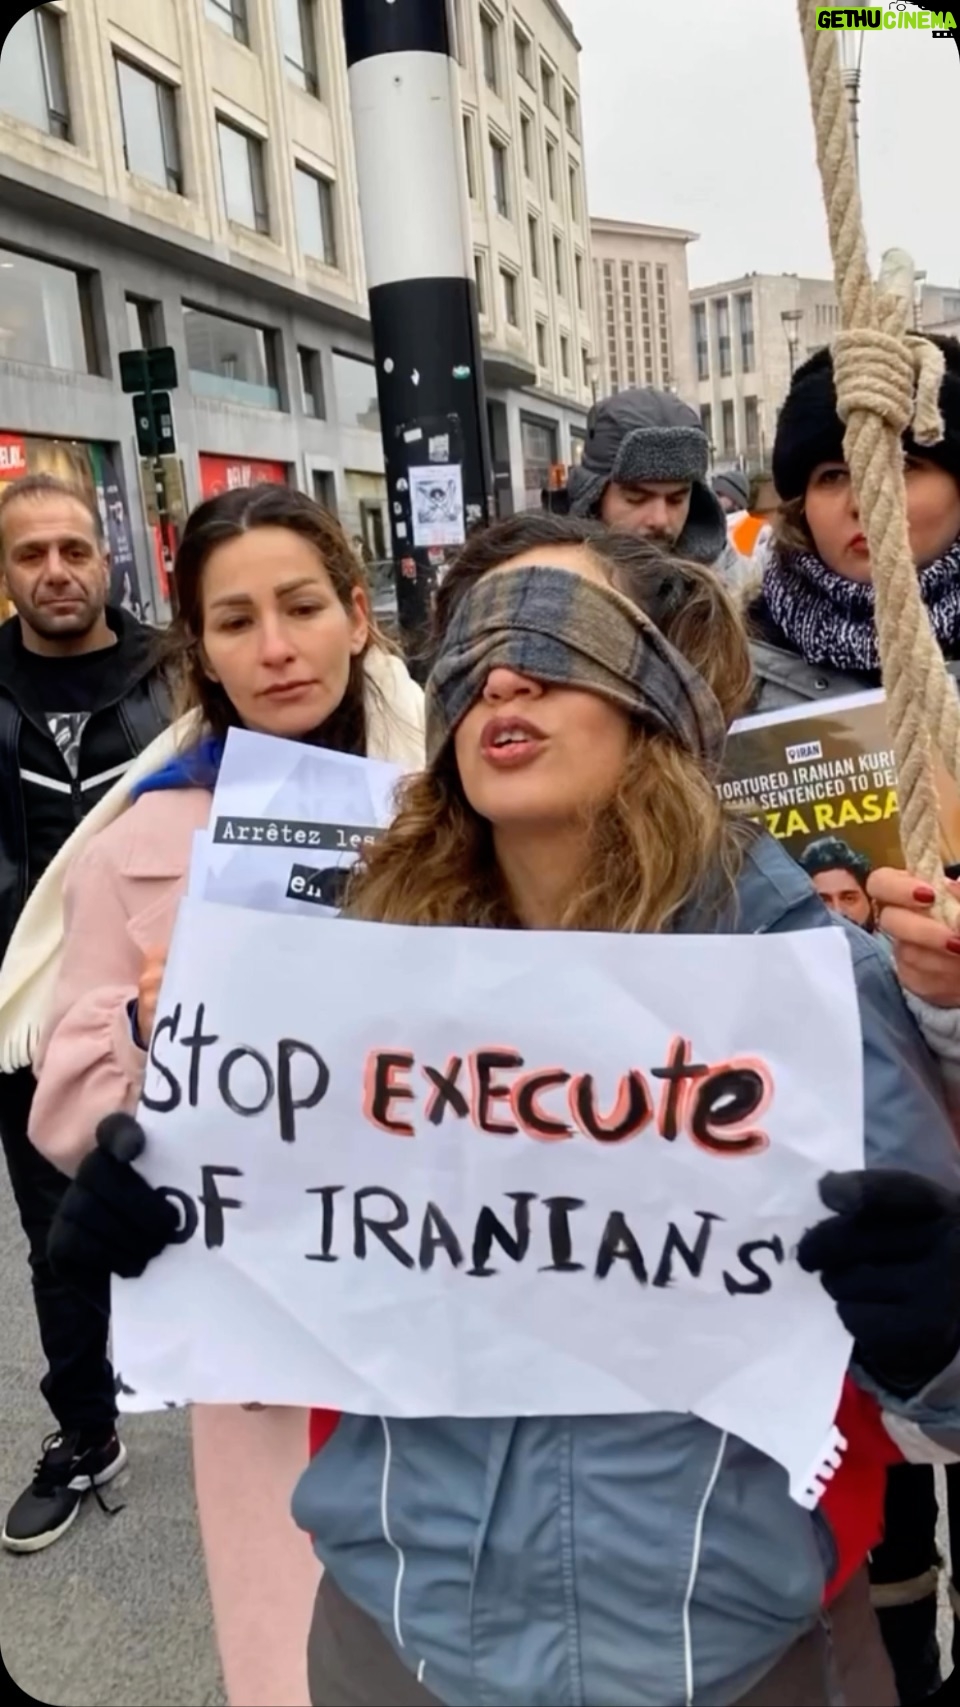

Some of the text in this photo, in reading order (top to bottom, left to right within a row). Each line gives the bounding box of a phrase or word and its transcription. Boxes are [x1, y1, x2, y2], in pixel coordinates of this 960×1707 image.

[796, 745, 819, 758] IRAN
[715, 749, 896, 800] TORTURED IRANIAN KUR
[760, 780, 844, 810] SENTENCED
[850, 773, 869, 793] TO
[872, 769, 899, 789] DE
[222, 821, 321, 845] Arrêtez
[750, 808, 810, 840] ZA
[304, 1184, 783, 1296] IRANIANS
